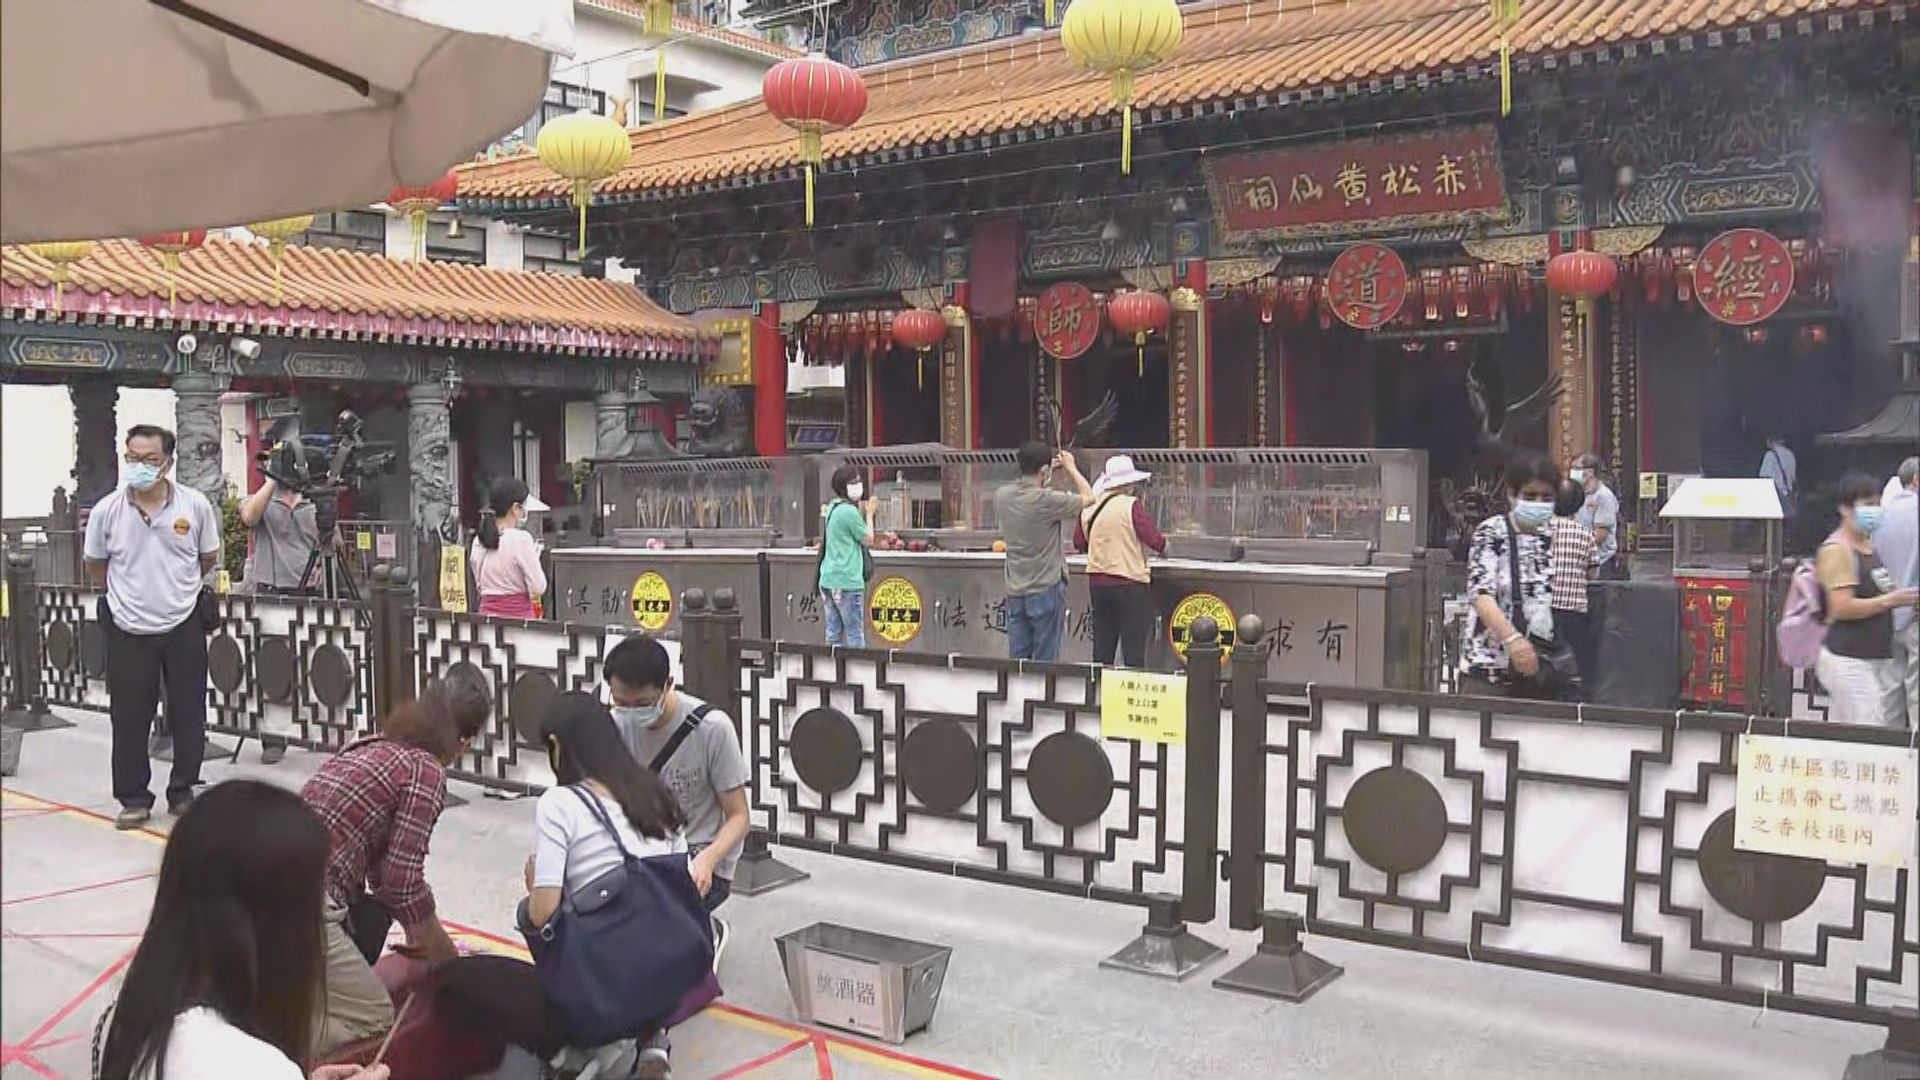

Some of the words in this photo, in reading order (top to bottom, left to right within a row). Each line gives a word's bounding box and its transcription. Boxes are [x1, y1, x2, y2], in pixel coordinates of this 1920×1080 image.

[1343, 248, 1389, 311] 道
[1048, 299, 1082, 341] 師
[1754, 752, 1901, 785] 跪拜區範圍禁
